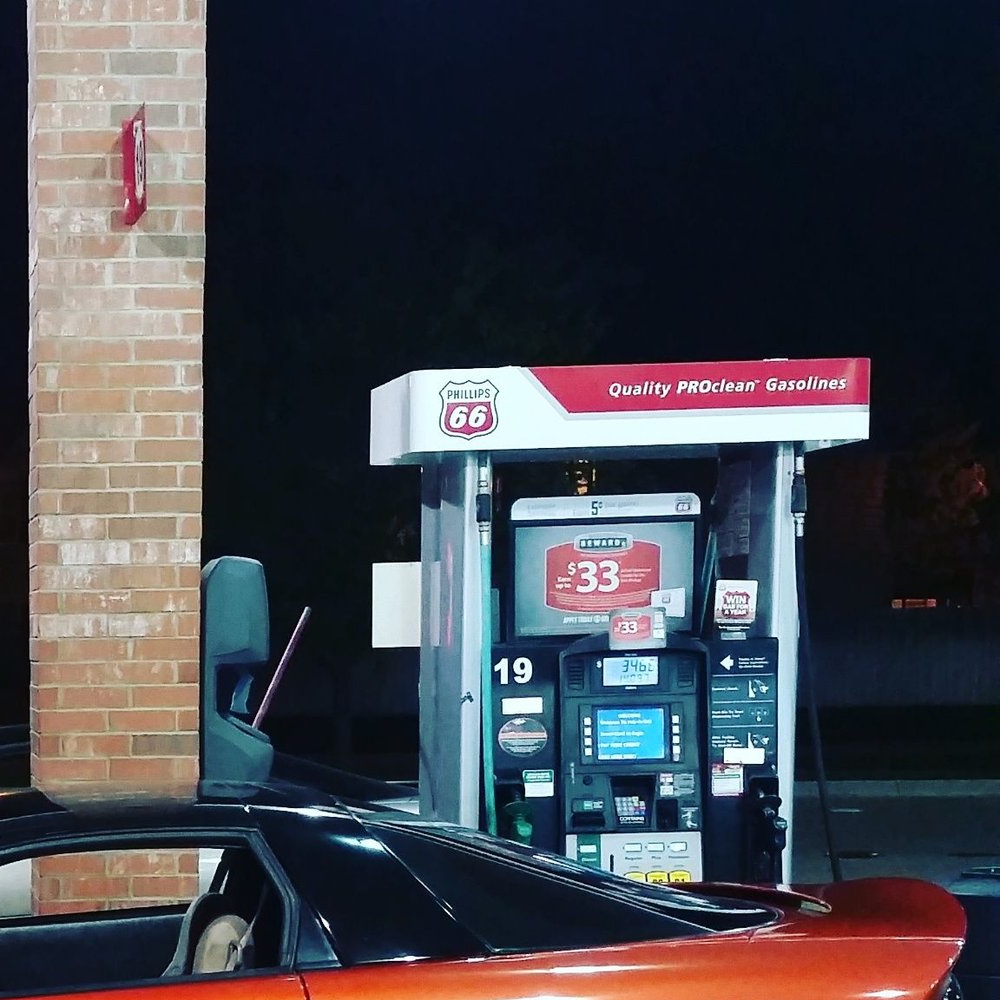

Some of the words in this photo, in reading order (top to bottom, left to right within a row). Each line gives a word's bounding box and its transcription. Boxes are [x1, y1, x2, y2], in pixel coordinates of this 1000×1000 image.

[447, 388, 491, 399] PHILLIPS
[608, 382, 671, 398] Quality
[765, 376, 847, 392] Gasolines
[449, 404, 489, 429] 66
[726, 595, 746, 604] WIN
[494, 657, 533, 684] 19
